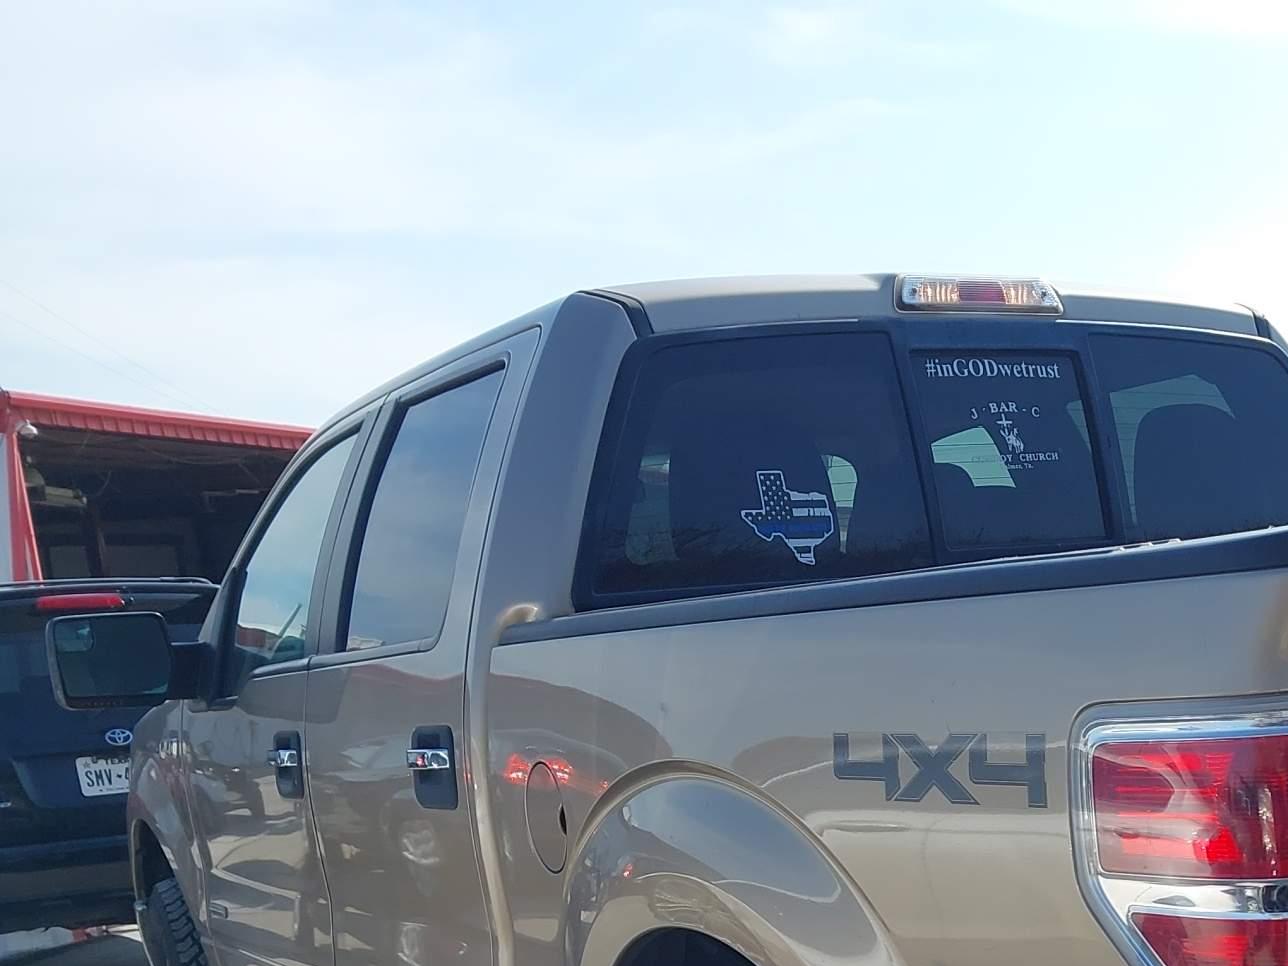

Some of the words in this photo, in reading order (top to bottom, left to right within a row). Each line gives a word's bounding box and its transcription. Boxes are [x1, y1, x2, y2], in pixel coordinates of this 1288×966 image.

[925, 358, 1061, 379] #inGODwetrust
[970, 408, 978, 420] J
[988, 401, 1019, 414] BAR
[1031, 406, 1040, 418] C
[1019, 452, 1059, 462] CHURCH
